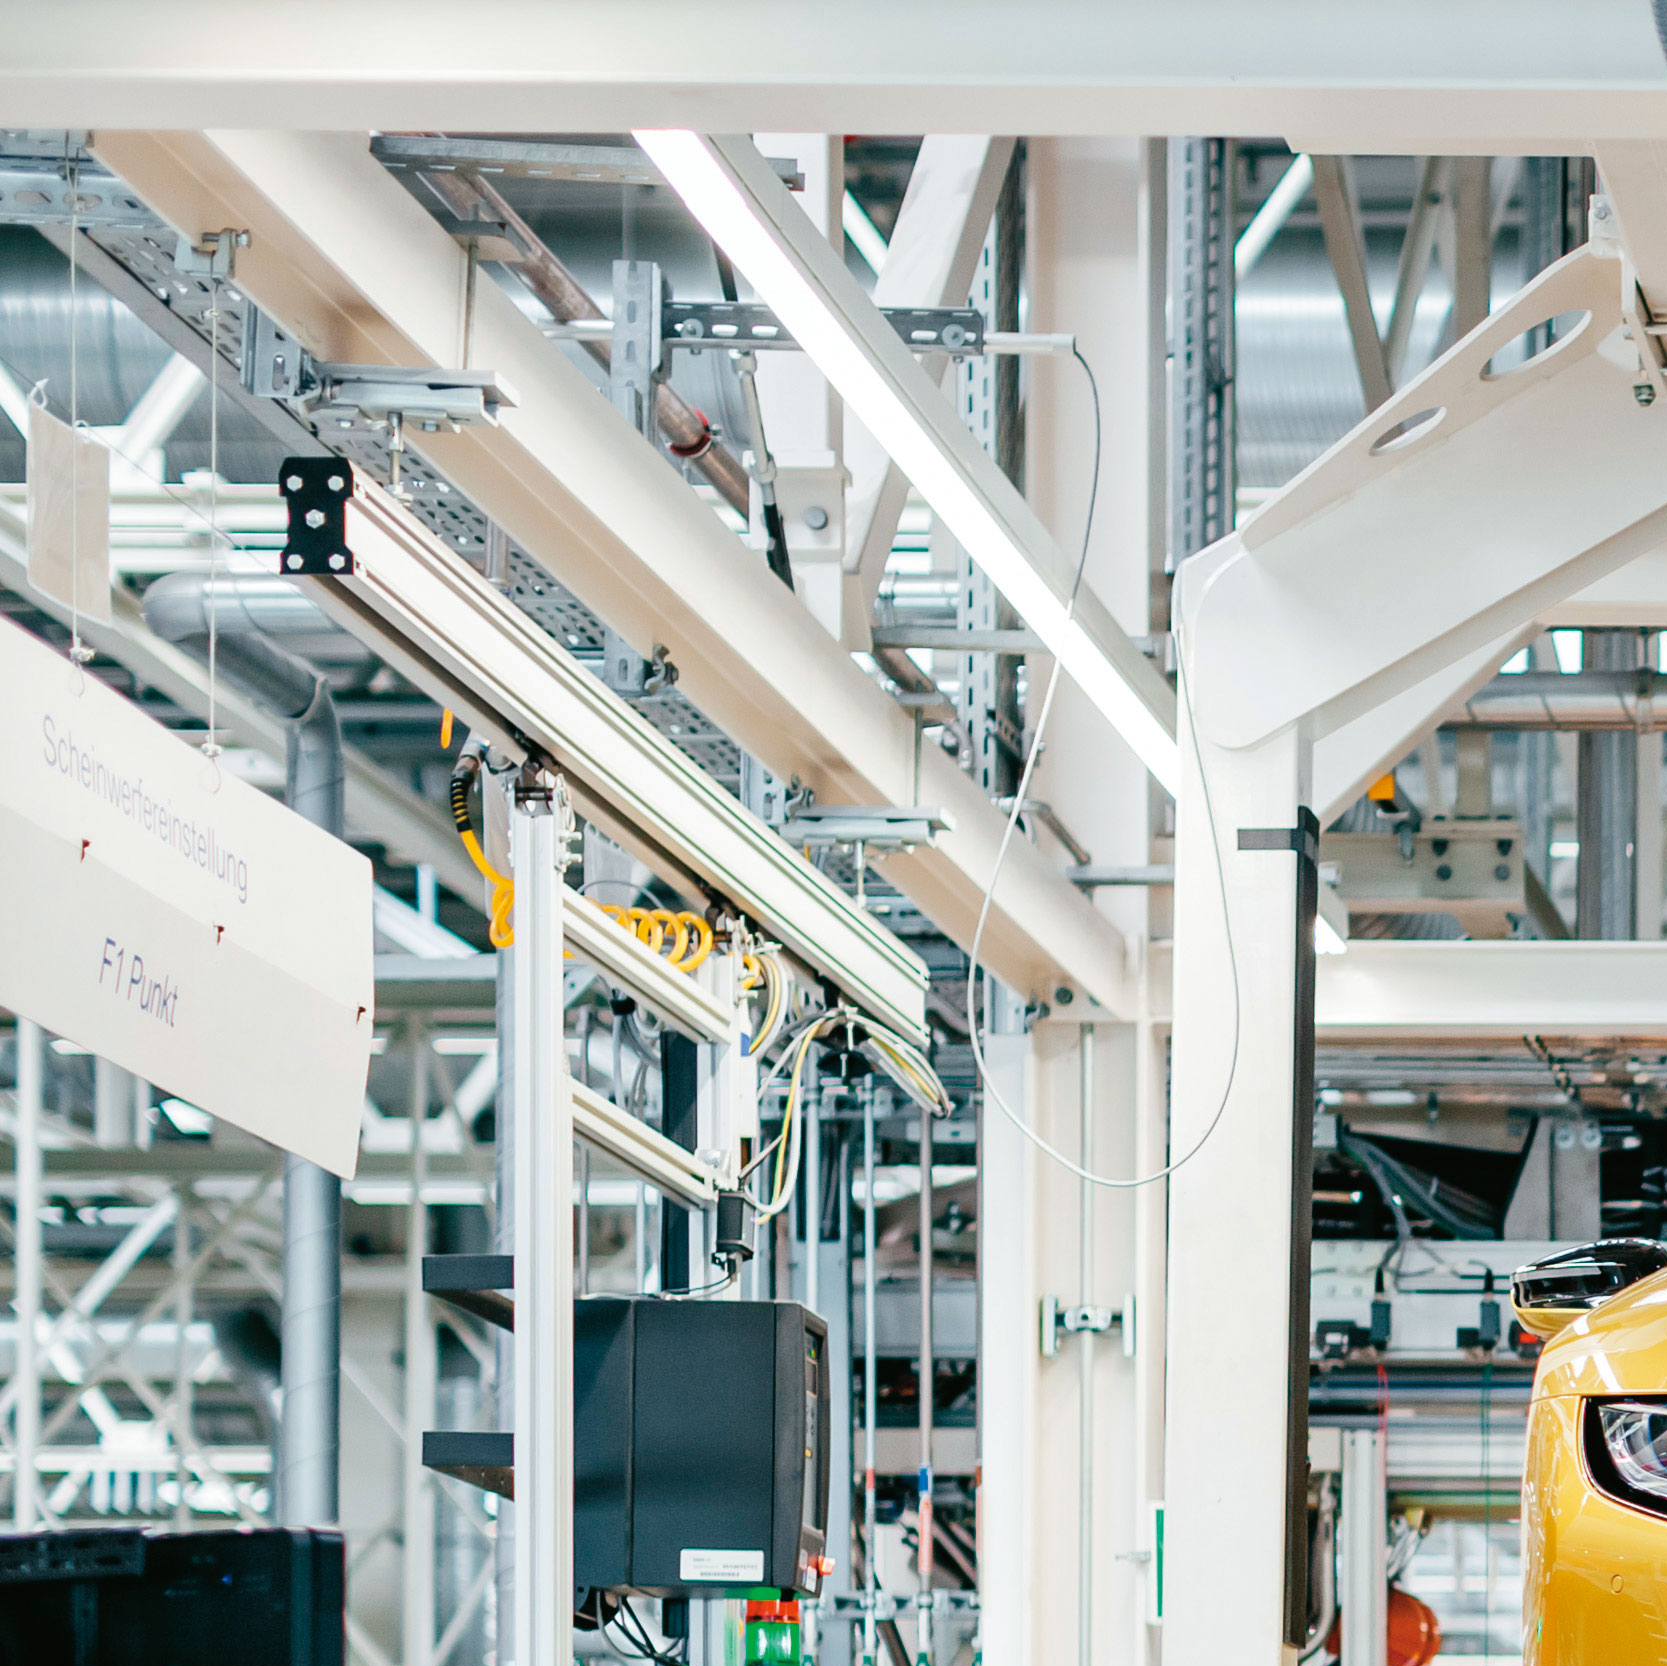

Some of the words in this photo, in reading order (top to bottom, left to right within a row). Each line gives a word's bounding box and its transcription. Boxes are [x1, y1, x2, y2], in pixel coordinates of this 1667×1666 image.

[42, 715, 249, 904] Scheinwerfereinstellung
[99, 937, 124, 993] F1
[127, 954, 179, 1027] Punkt
